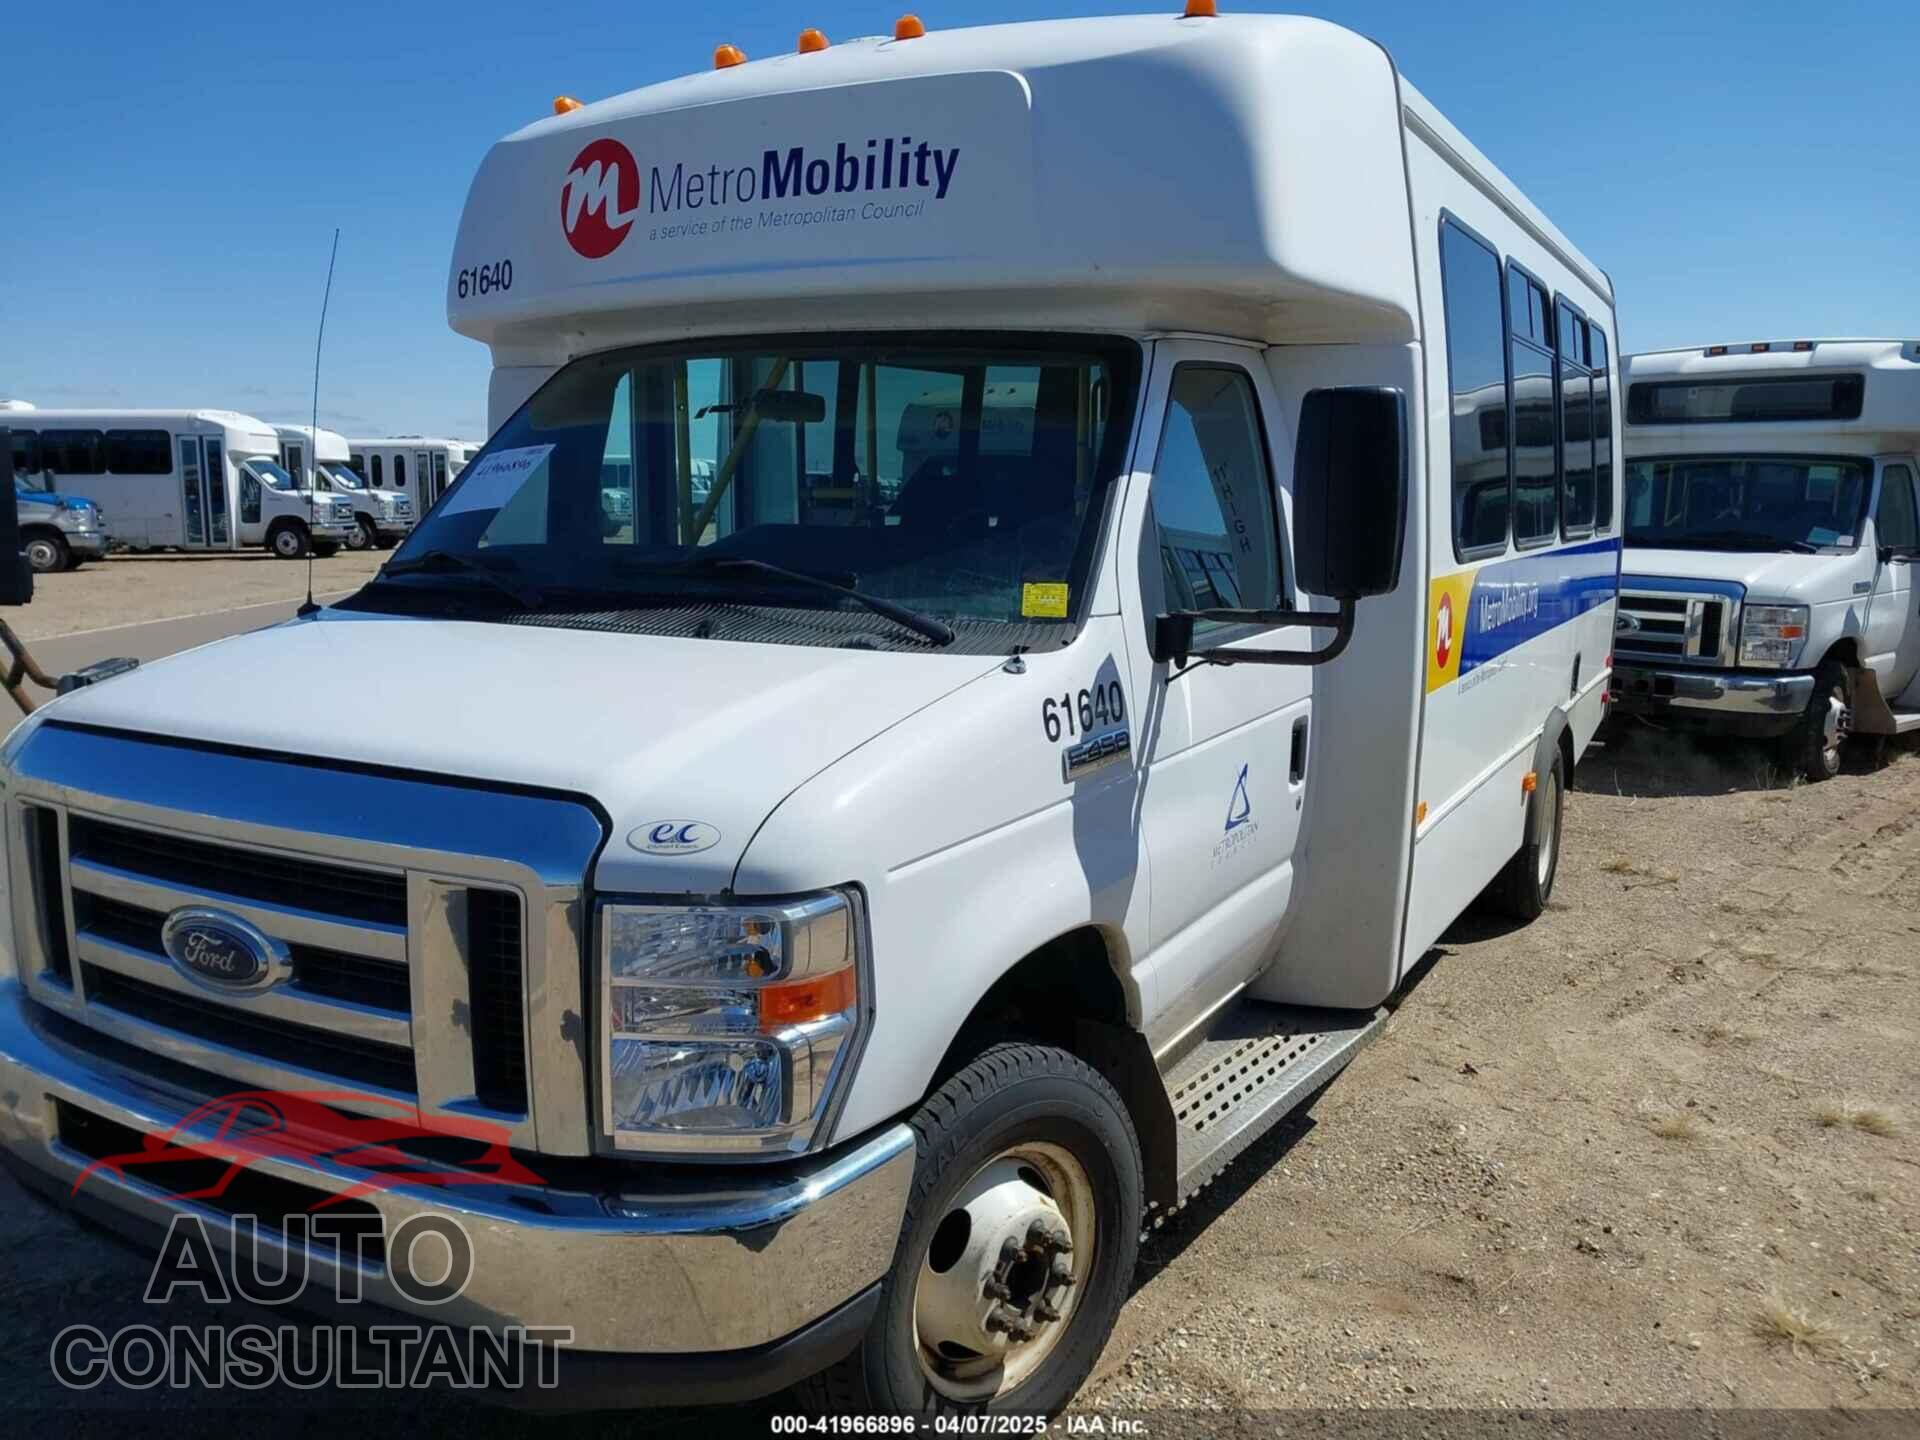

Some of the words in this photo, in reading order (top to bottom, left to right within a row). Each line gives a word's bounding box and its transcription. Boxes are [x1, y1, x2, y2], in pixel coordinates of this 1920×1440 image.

[649, 229, 657, 241] a
[660, 218, 708, 240] service
[711, 217, 726, 233] of
[730, 214, 753, 232] the
[757, 205, 856, 230] Metropolitan
[861, 200, 925, 221] Council
[458, 258, 513, 299] 61640
[1042, 681, 1125, 743] 61640
[184, 932, 235, 972] Ford
